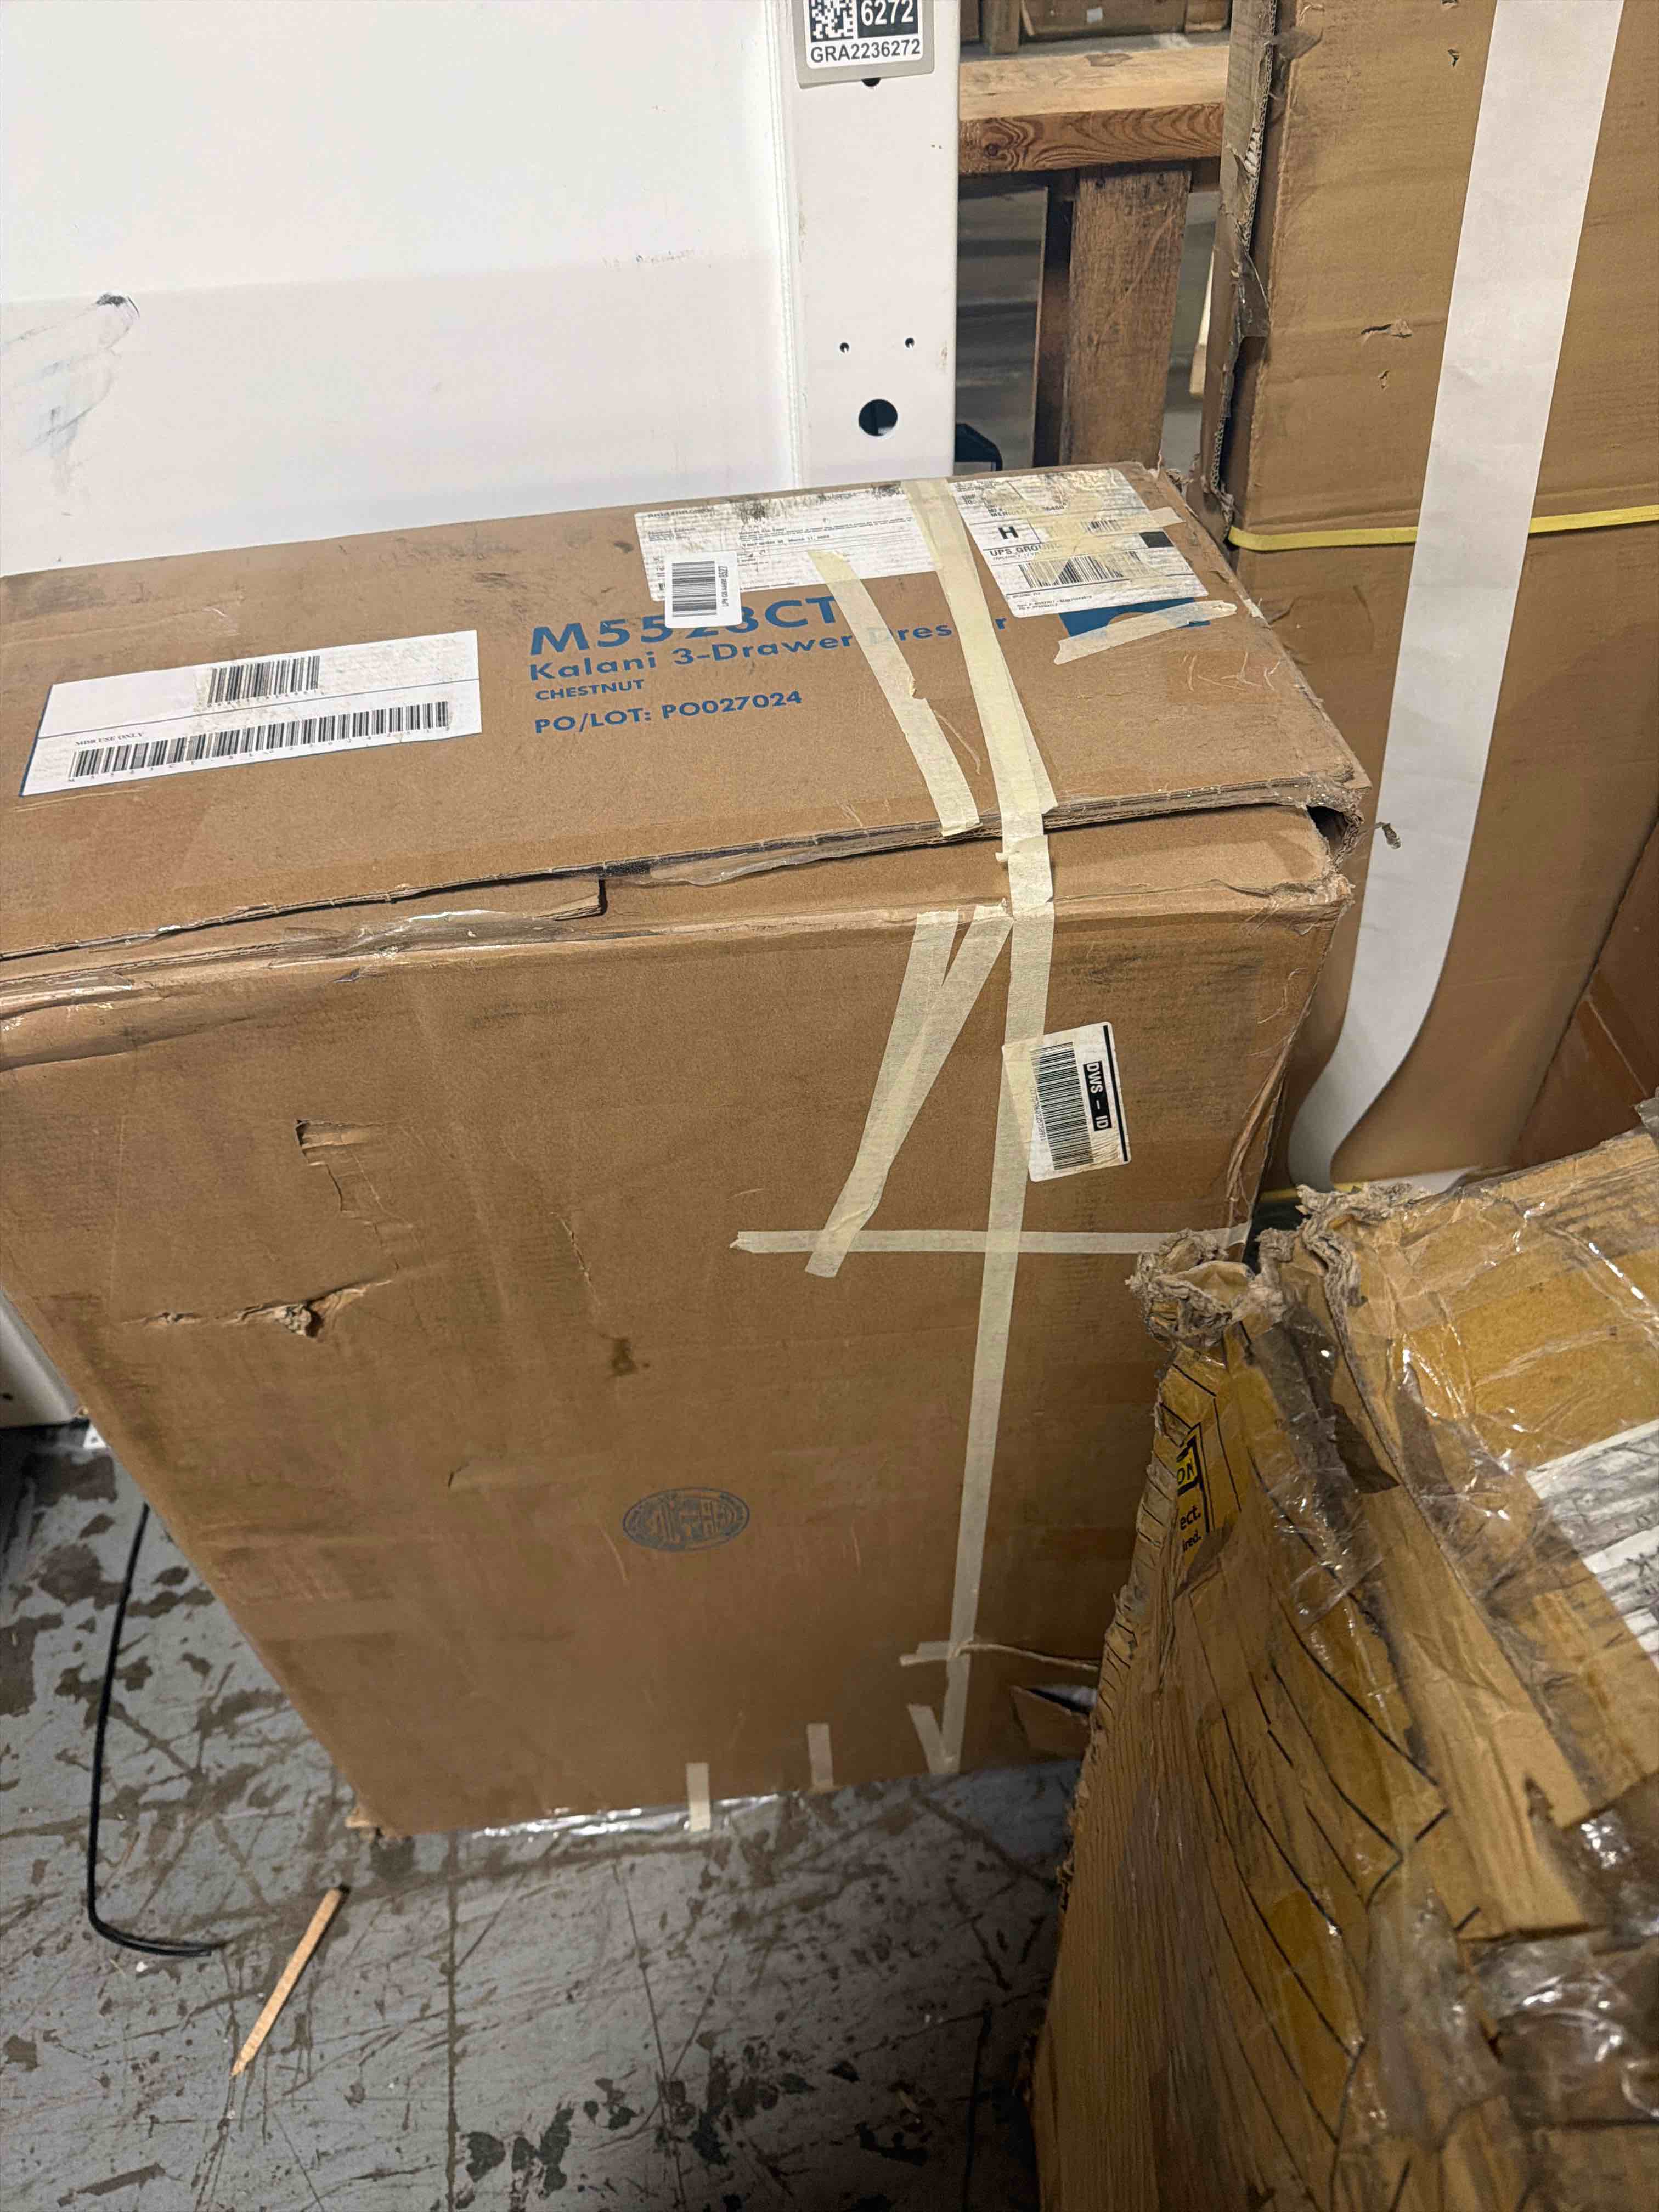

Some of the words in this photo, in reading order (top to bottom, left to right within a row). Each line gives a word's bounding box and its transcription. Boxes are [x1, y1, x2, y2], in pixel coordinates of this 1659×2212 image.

[860, 0, 914, 26] 6272
[810, 39, 921, 63] GRA2236272
[998, 526, 1019, 539] H
[529, 651, 657, 681] Kalani
[673, 632, 853, 665] 3-Drawer
[868, 617, 1006, 645] resr
[535, 679, 645, 701] CHESTNUT
[535, 708, 652, 733] PO/LOT:
[1086, 1062, 1103, 1094] DWS
[1096, 1115, 1109, 1128] ID
